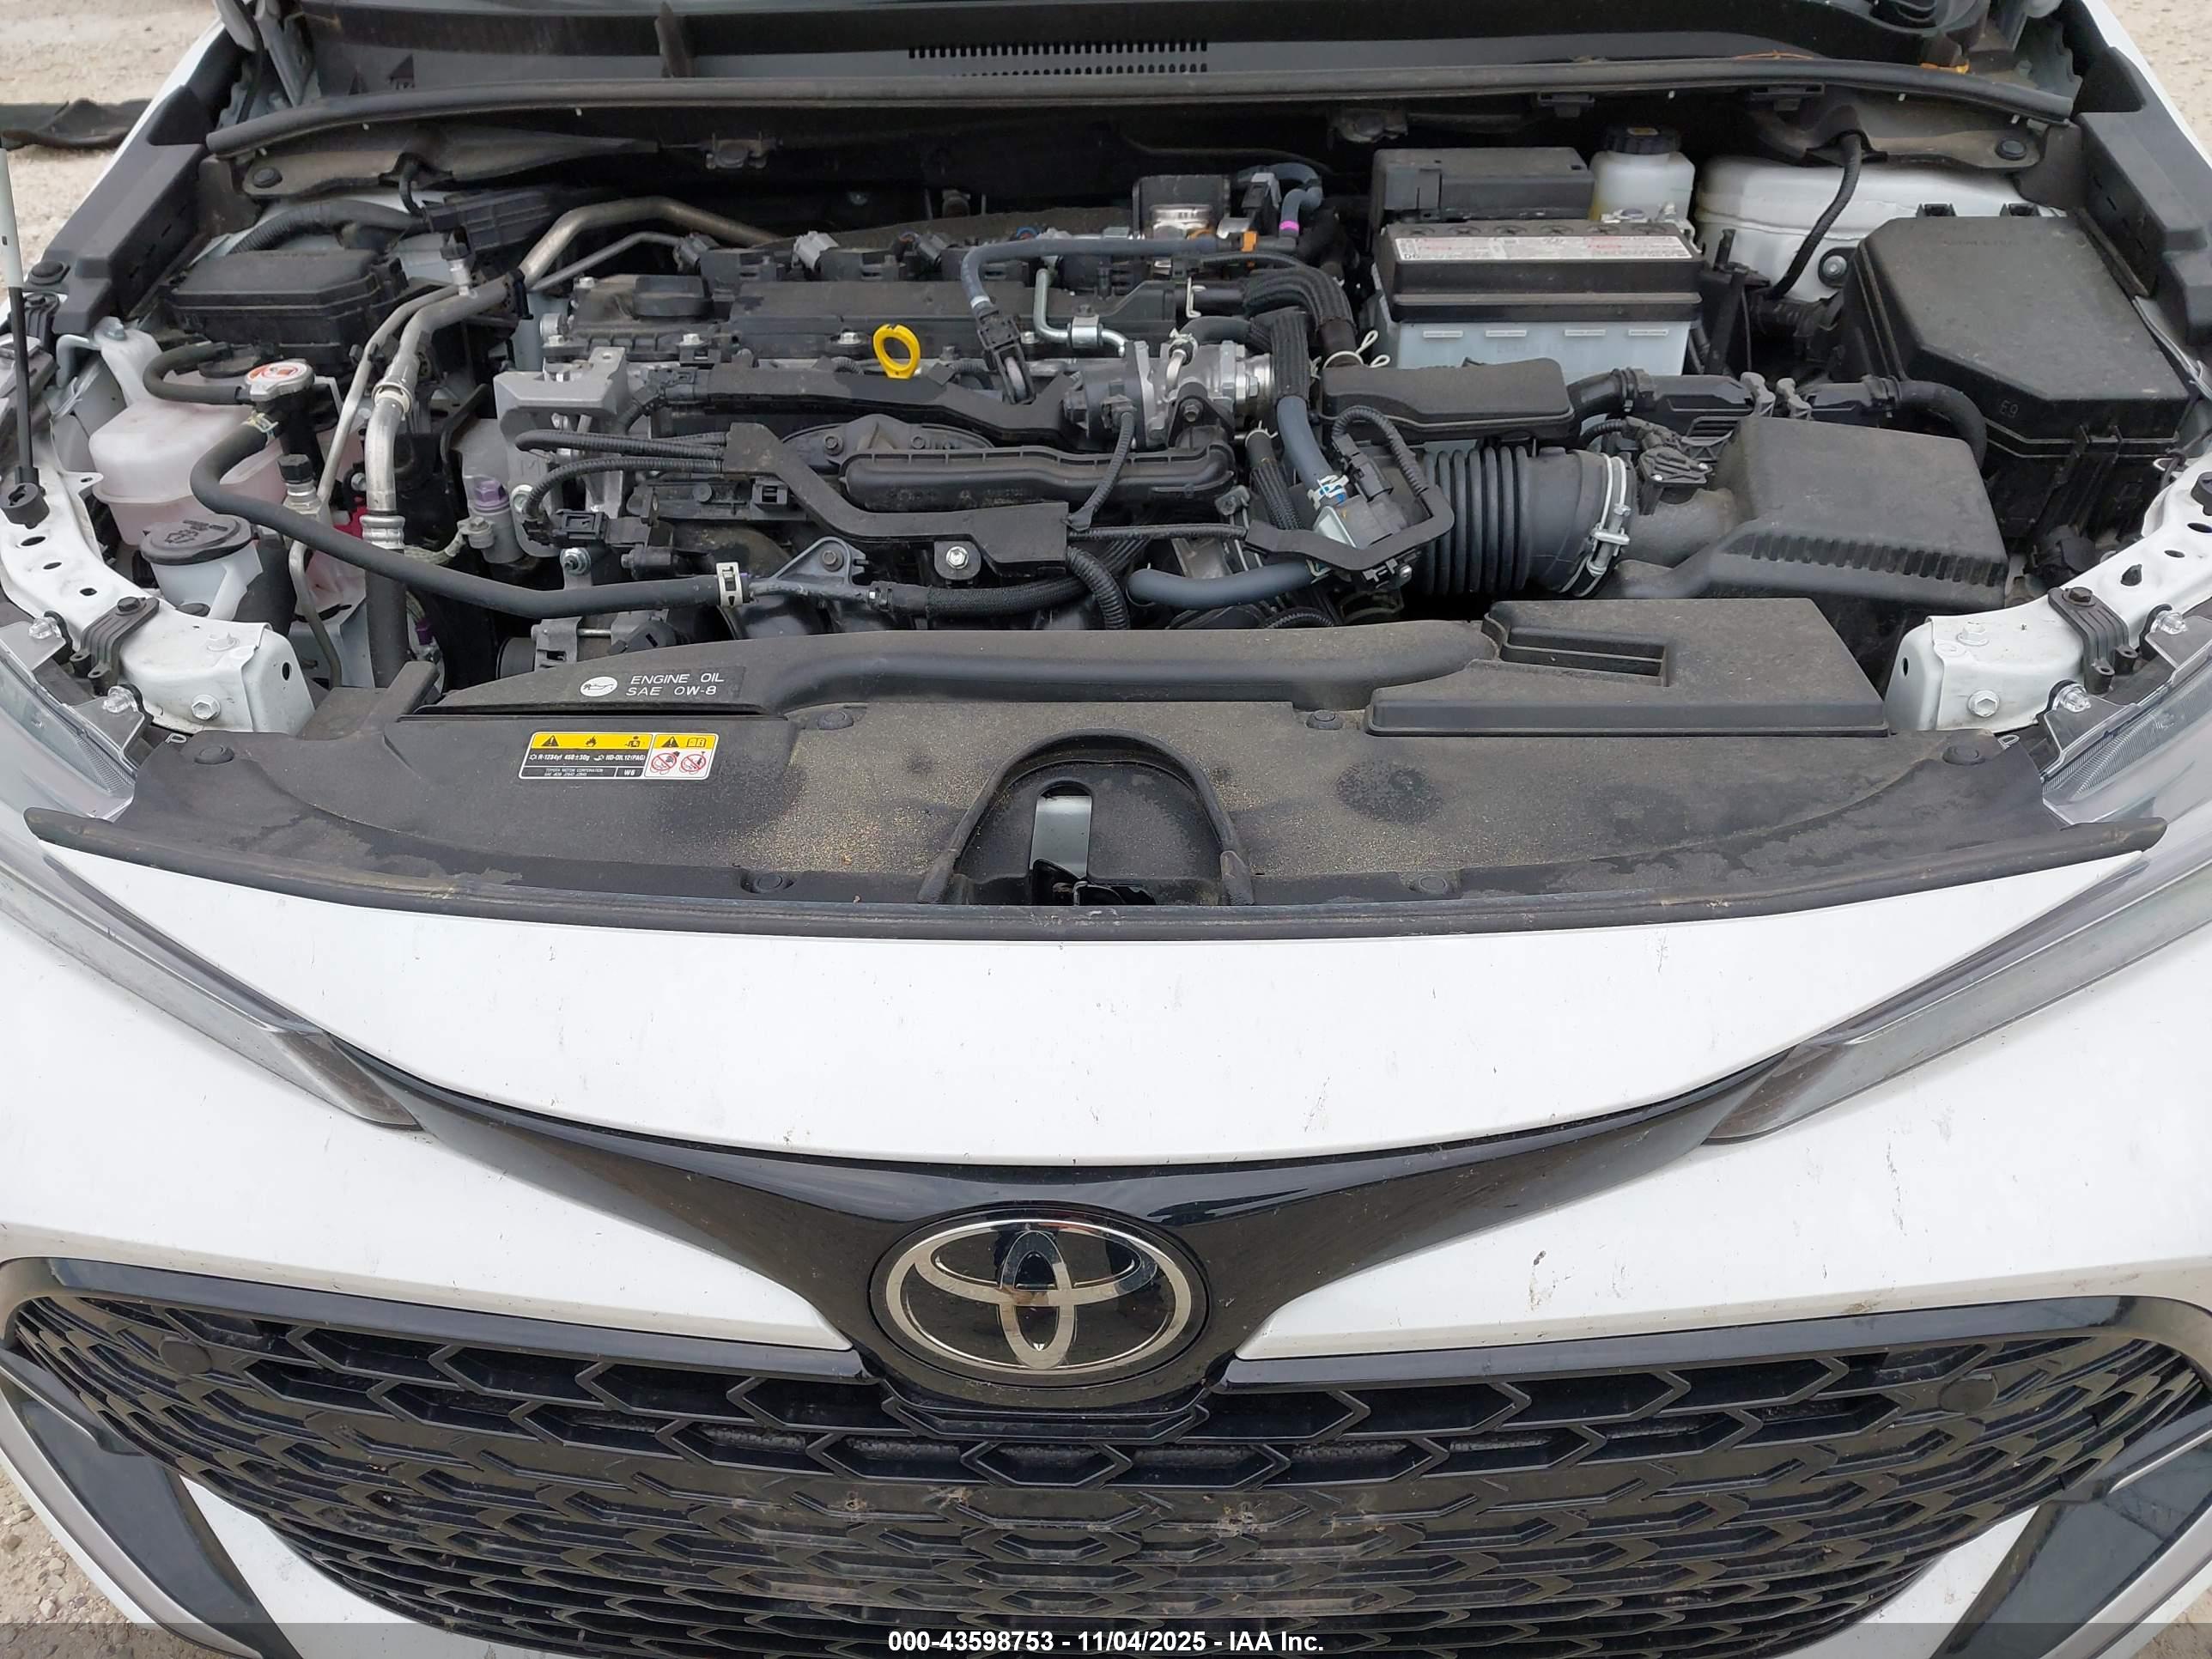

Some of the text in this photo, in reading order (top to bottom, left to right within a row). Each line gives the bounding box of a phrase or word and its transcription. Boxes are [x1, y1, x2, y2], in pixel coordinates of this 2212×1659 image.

[630, 672, 725, 685] ENGINE OIL
[625, 686, 663, 696] SAE
